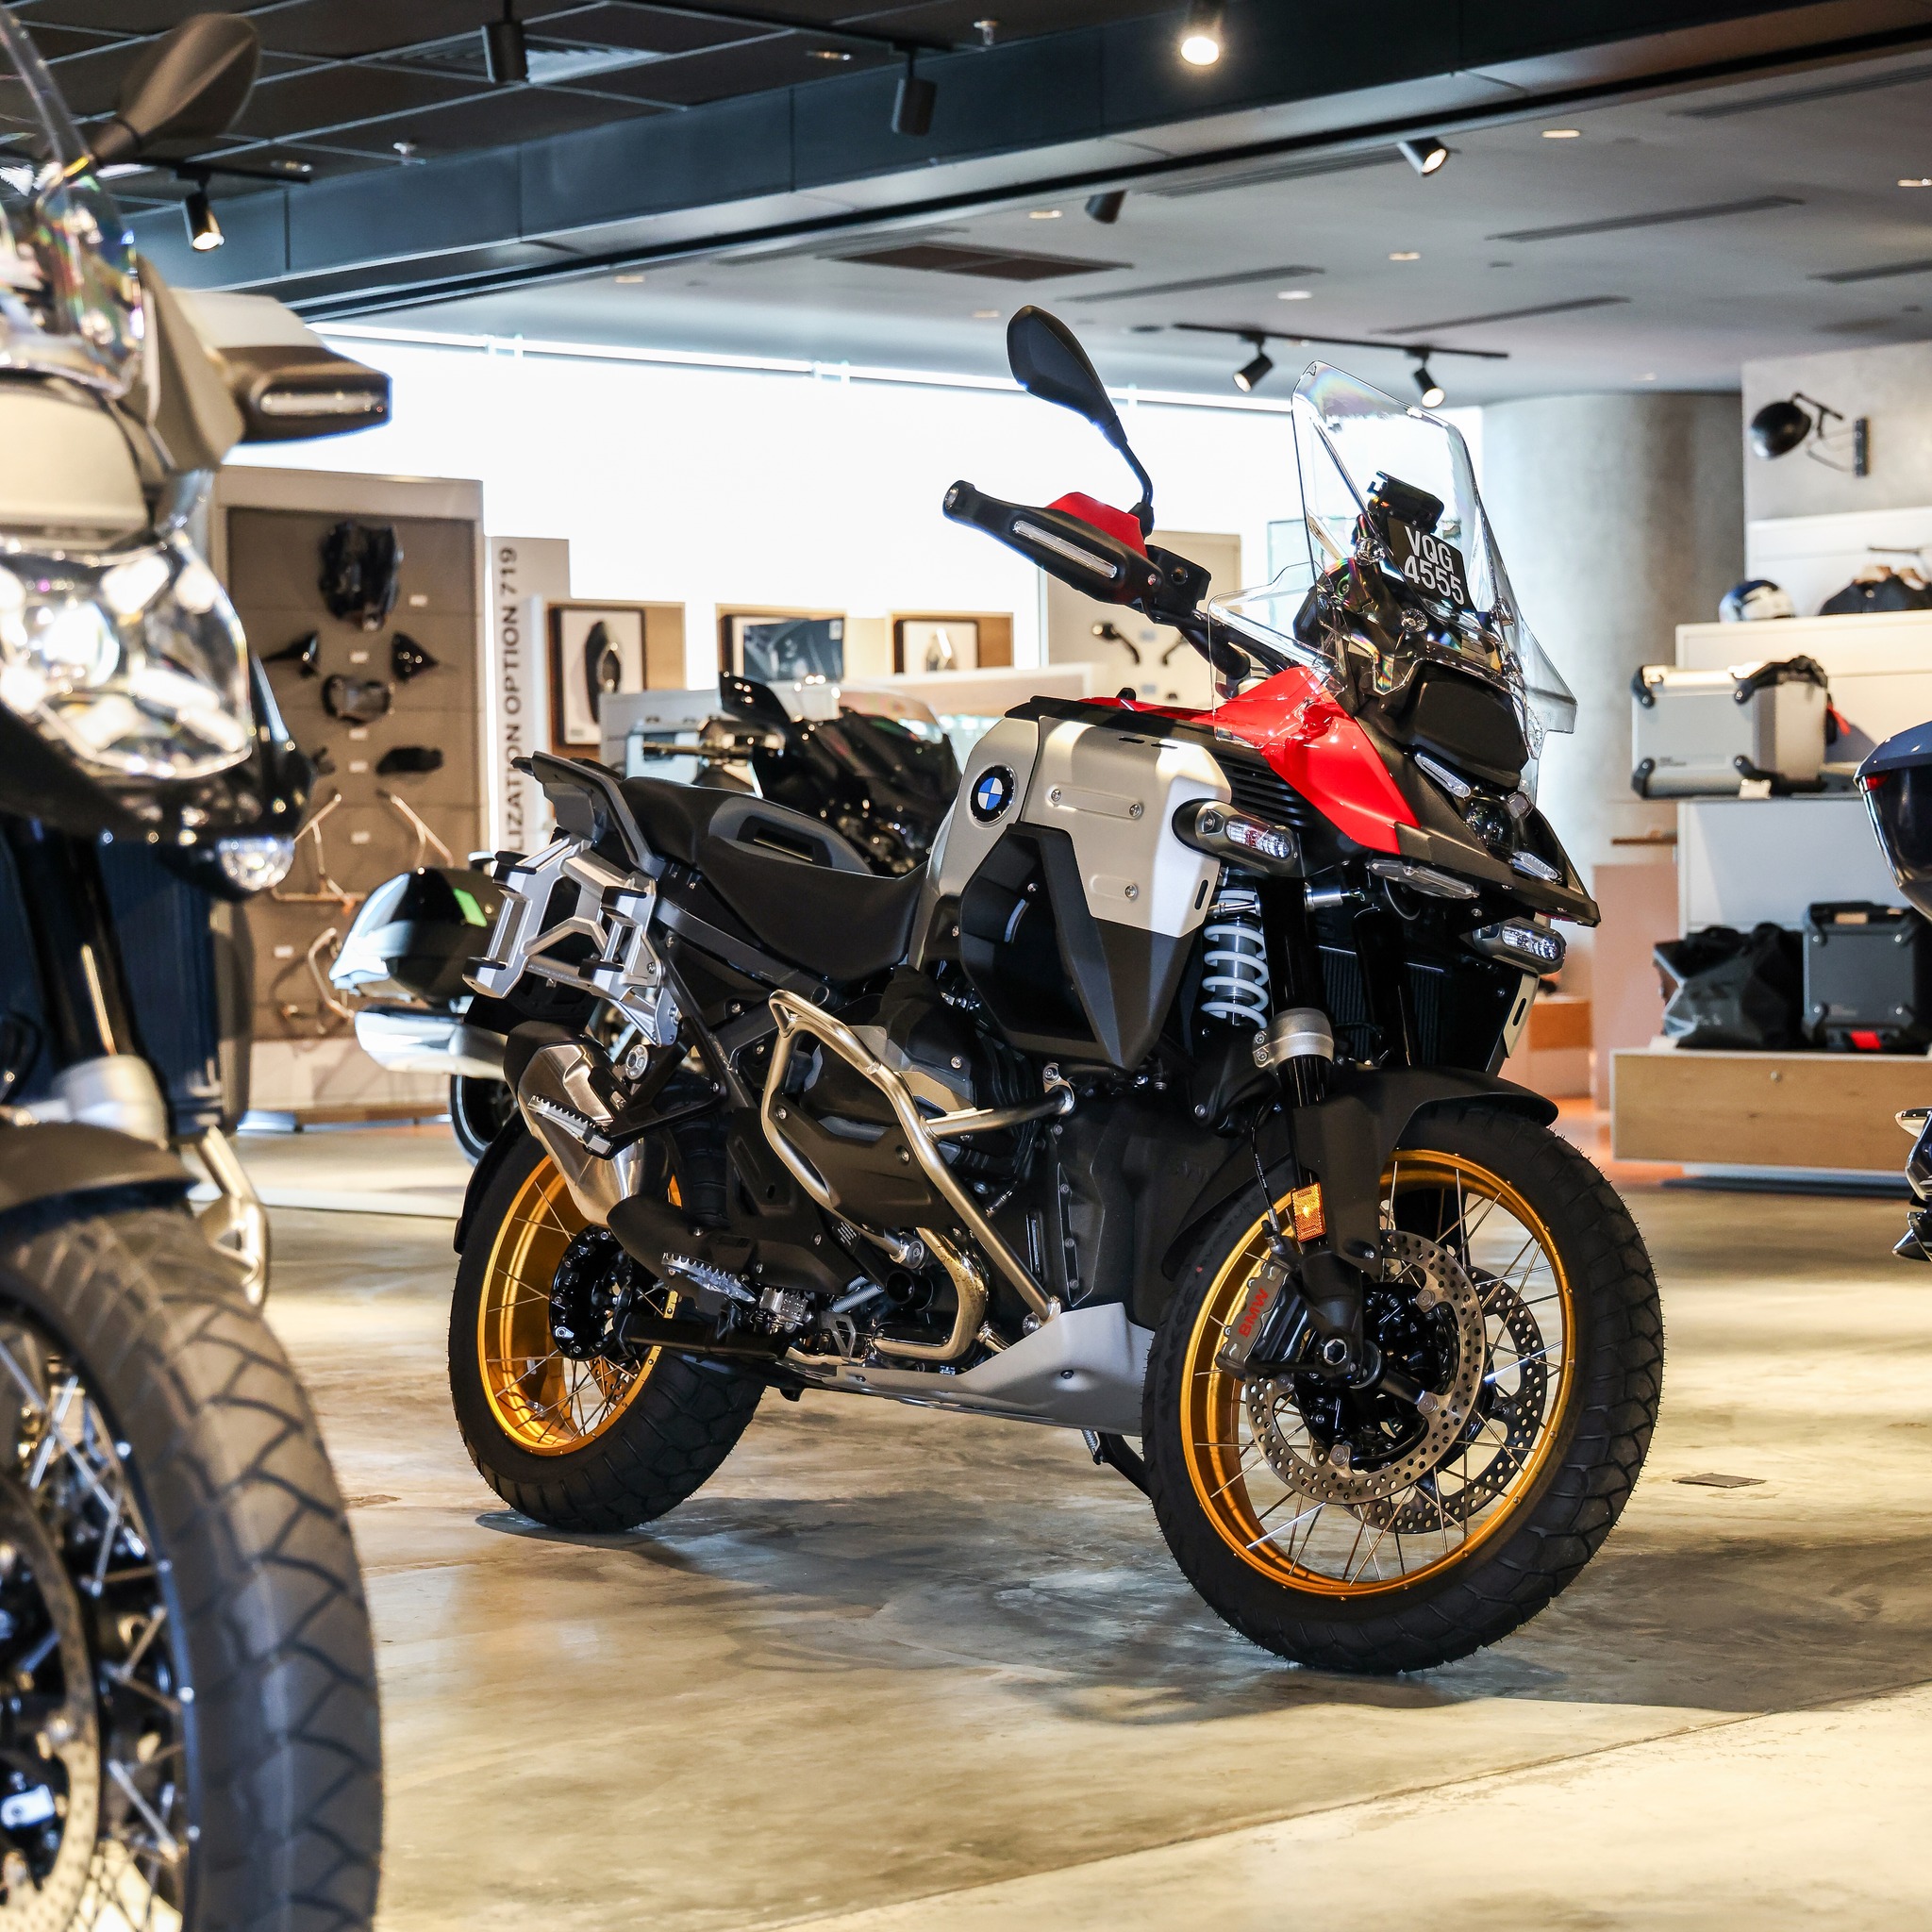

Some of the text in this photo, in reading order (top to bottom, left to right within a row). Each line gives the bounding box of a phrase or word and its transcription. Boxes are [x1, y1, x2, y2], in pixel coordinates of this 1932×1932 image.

[499, 546, 518, 595] 719
[1404, 525, 1455, 575] VQG
[1404, 555, 1465, 606] 4555
[502, 605, 521, 714] OPTION
[1238, 1287, 1269, 1338] BMW
